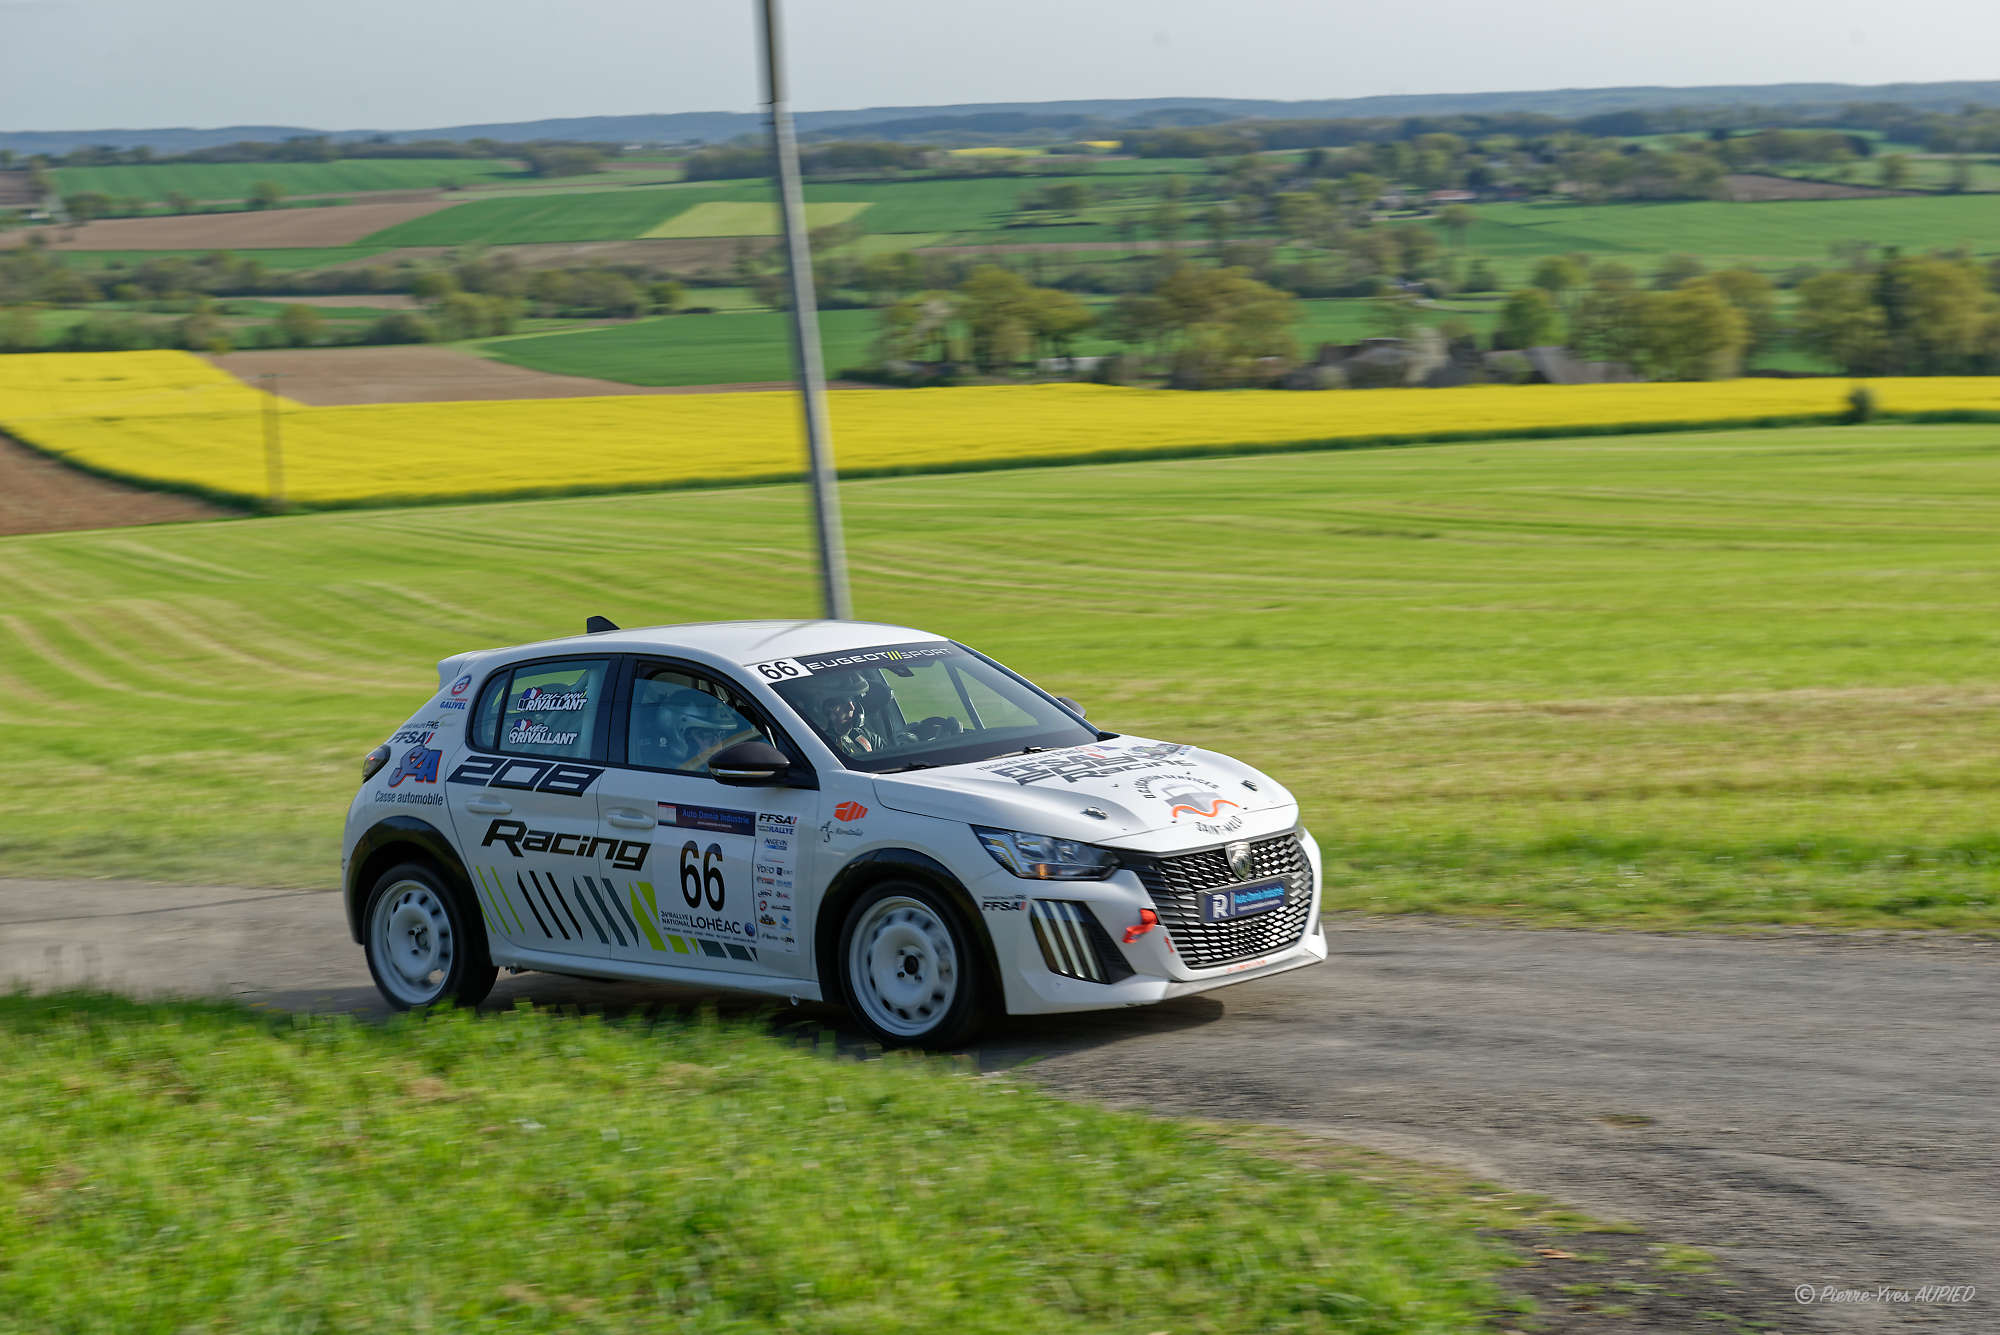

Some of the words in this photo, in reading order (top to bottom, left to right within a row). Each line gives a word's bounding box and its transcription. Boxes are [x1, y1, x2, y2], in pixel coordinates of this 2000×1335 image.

[757, 661, 799, 680] 66
[806, 652, 889, 670] EUGEOT
[526, 698, 587, 711] RIVALLANT
[388, 730, 431, 745] FFSA
[516, 731, 577, 745] RIVALLANT
[447, 755, 606, 798] 208
[375, 790, 397, 803] Casse
[397, 791, 444, 806] automobile
[759, 813, 792, 825] FFSA
[480, 818, 652, 872] Racing
[680, 840, 725, 911] 66
[689, 914, 742, 935] LOHÉAC
